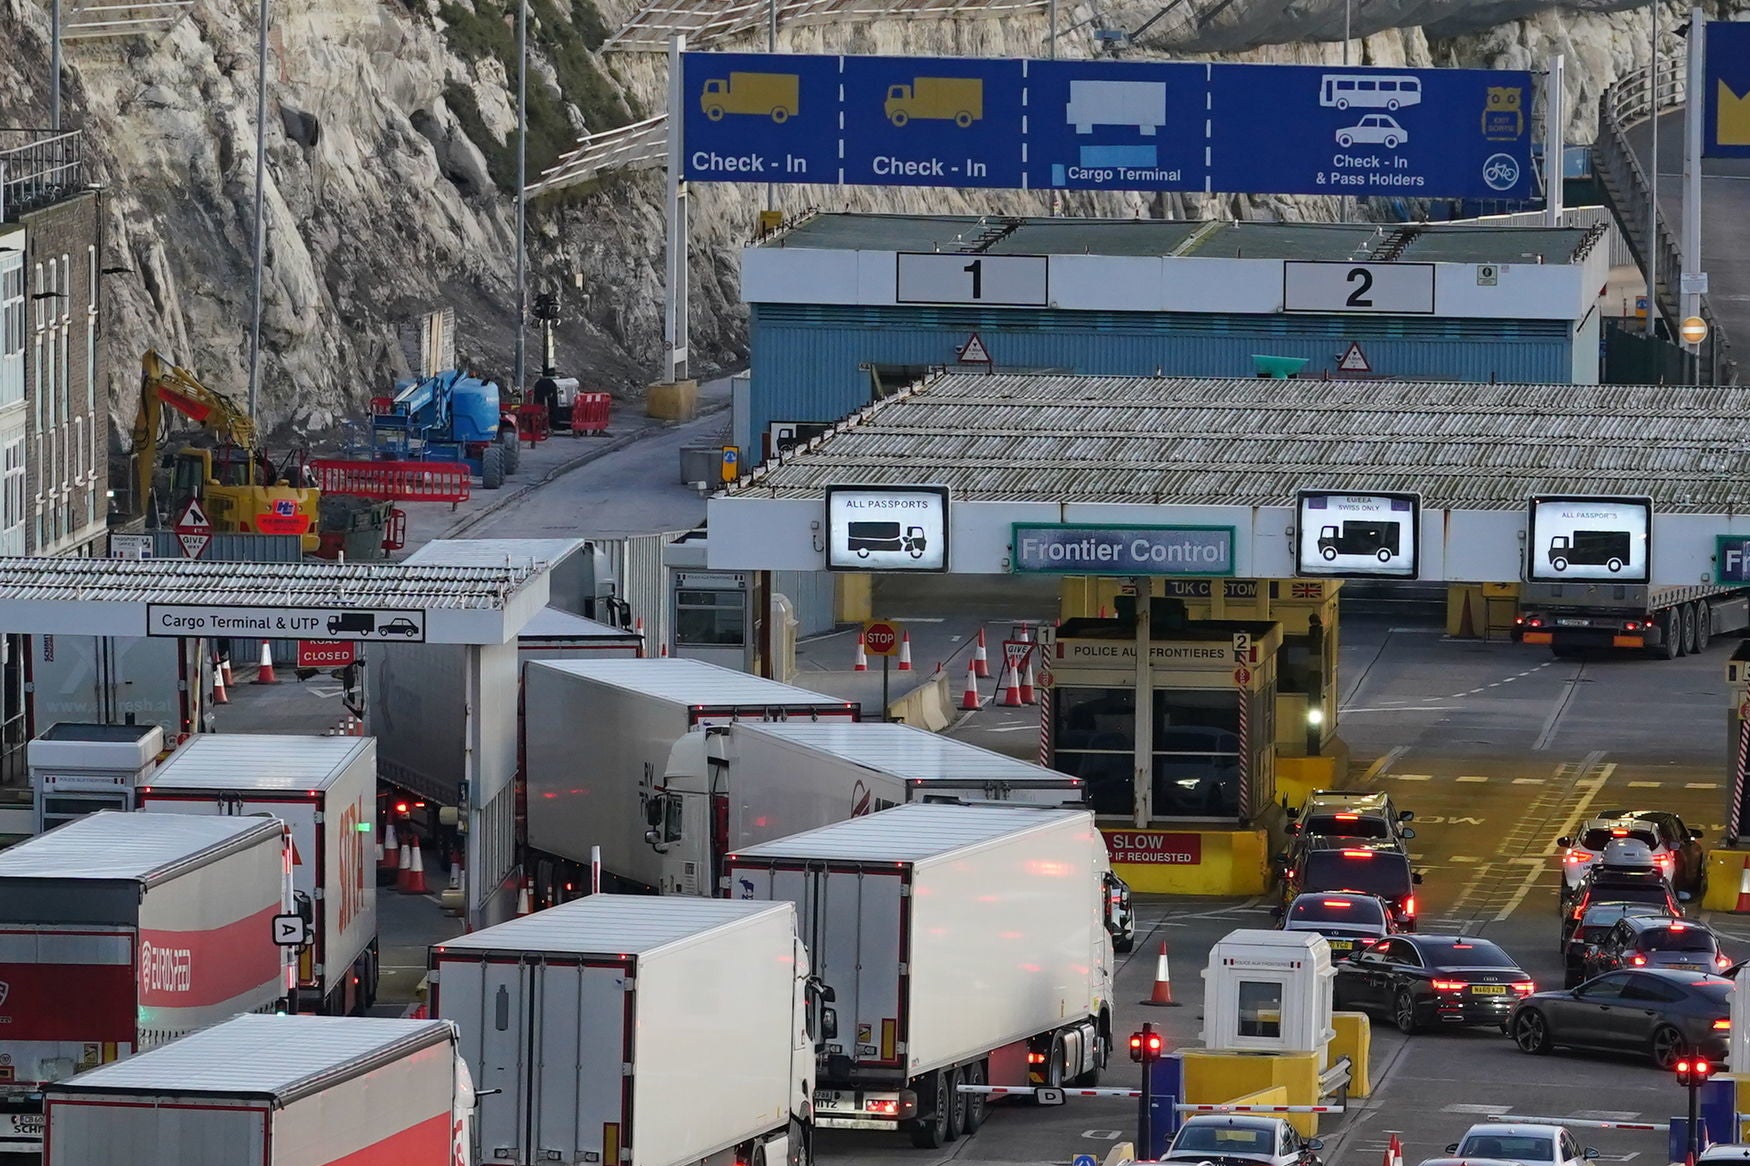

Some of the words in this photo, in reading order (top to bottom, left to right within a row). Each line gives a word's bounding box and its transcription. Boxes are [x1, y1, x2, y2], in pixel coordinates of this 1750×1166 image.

[692, 152, 764, 173] Check
[786, 155, 807, 173] In
[872, 156, 944, 176] Check
[967, 158, 987, 176] In
[1333, 155, 1380, 168] Check
[1393, 156, 1408, 168] In
[1068, 167, 1114, 183] Cargo
[1118, 167, 1181, 181] Terminal
[1316, 174, 1326, 185] &
[1330, 173, 1365, 185] Pass
[1369, 173, 1425, 186] Holders
[963, 260, 981, 299] 1
[1346, 268, 1373, 307] 2
[183, 536, 203, 544] GIVE
[1021, 539, 1123, 561] Frontier
[1130, 539, 1225, 562] Control
[1175, 582, 1195, 595] UK
[162, 614, 205, 629] Cargo
[210, 615, 271, 629] Terminal
[276, 616, 286, 629] &
[290, 617, 319, 630] UTP
[868, 633, 894, 644] STOP
[1042, 629, 1049, 643] 1
[1237, 635, 1247, 648] 2
[1008, 645, 1028, 653] GIVE
[1074, 646, 1118, 657] POLICE
[1121, 647, 1137, 657] AU
[1149, 647, 1224, 659] FRONTIERES
[303, 652, 350, 661] CLOSED
[1113, 835, 1164, 849] SLOW
[1115, 852, 1124, 861] IF
[1127, 852, 1191, 863] REQUESTED
[282, 925, 297, 938] A
[152, 948, 191, 992] EUROSPEED
[1044, 1092, 1056, 1101] D
